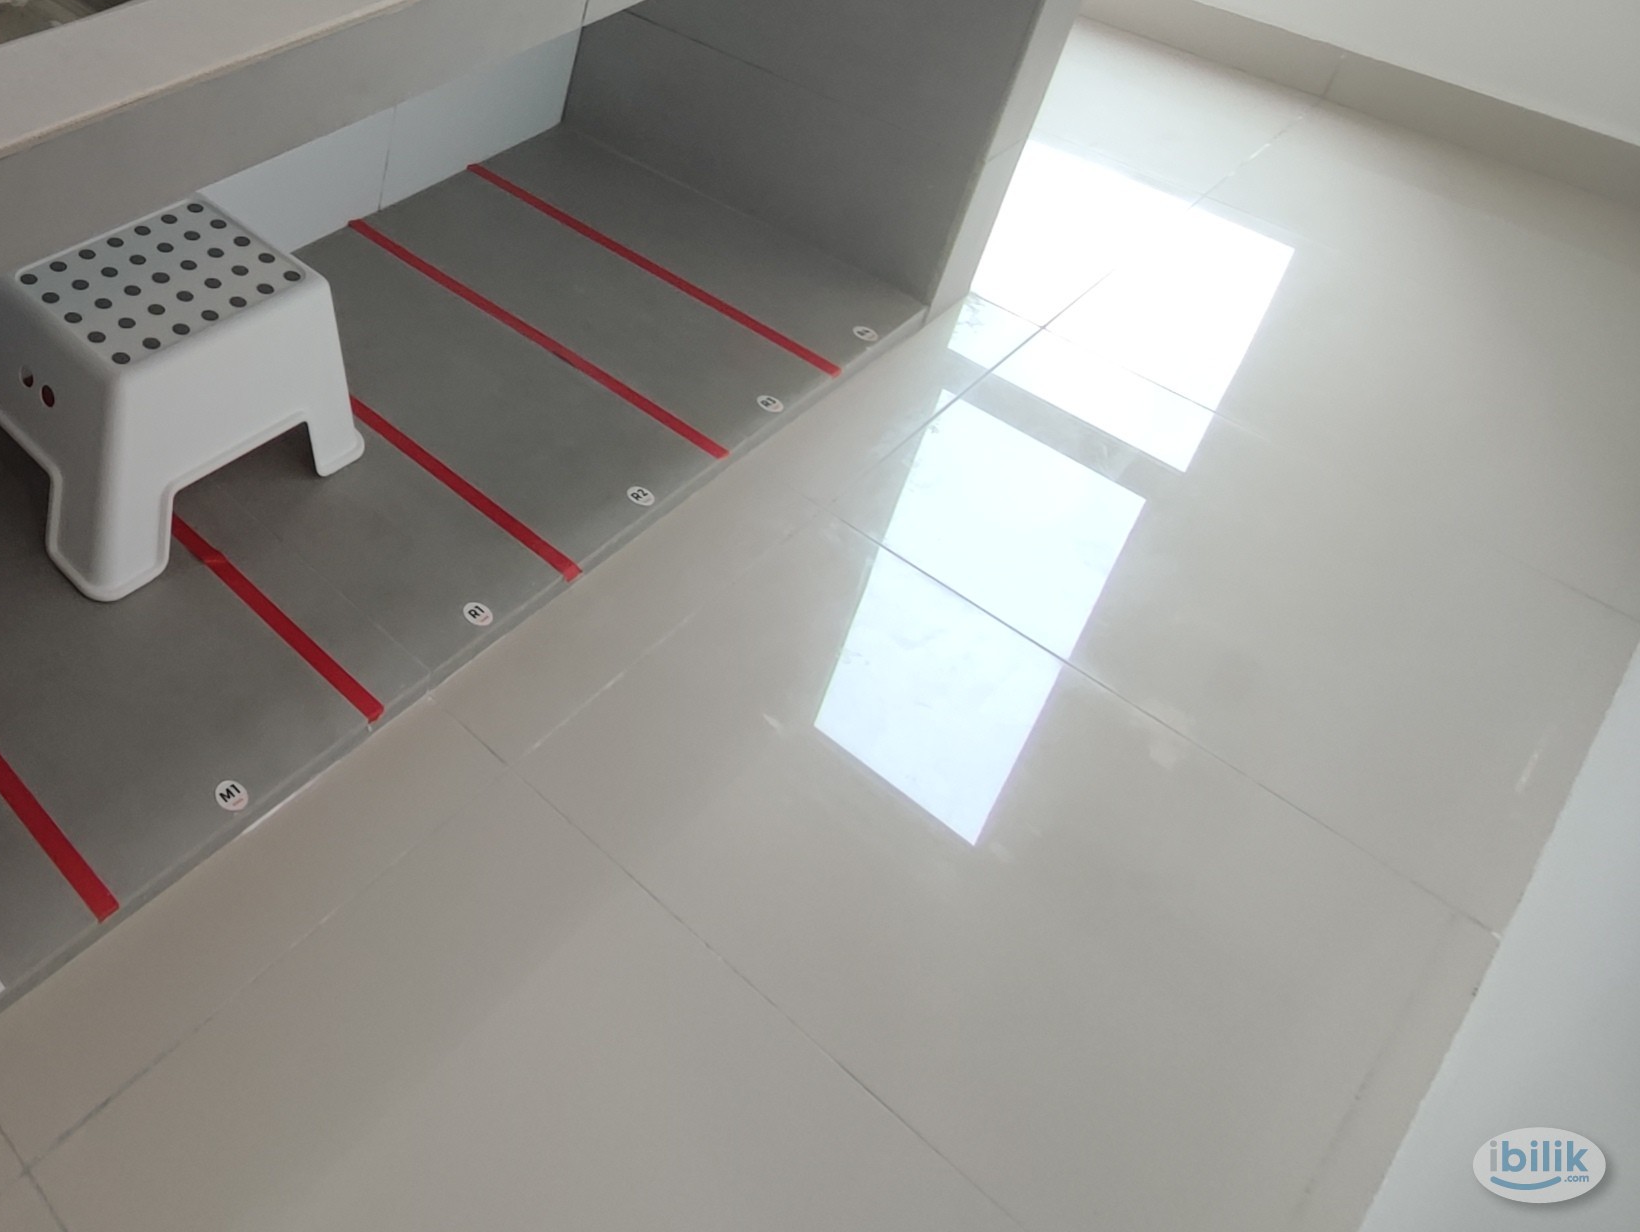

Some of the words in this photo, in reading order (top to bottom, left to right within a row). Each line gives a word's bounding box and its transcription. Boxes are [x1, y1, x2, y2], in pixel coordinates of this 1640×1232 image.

[630, 488, 648, 501] R2
[467, 605, 485, 619] R1
[219, 783, 241, 803] M1
